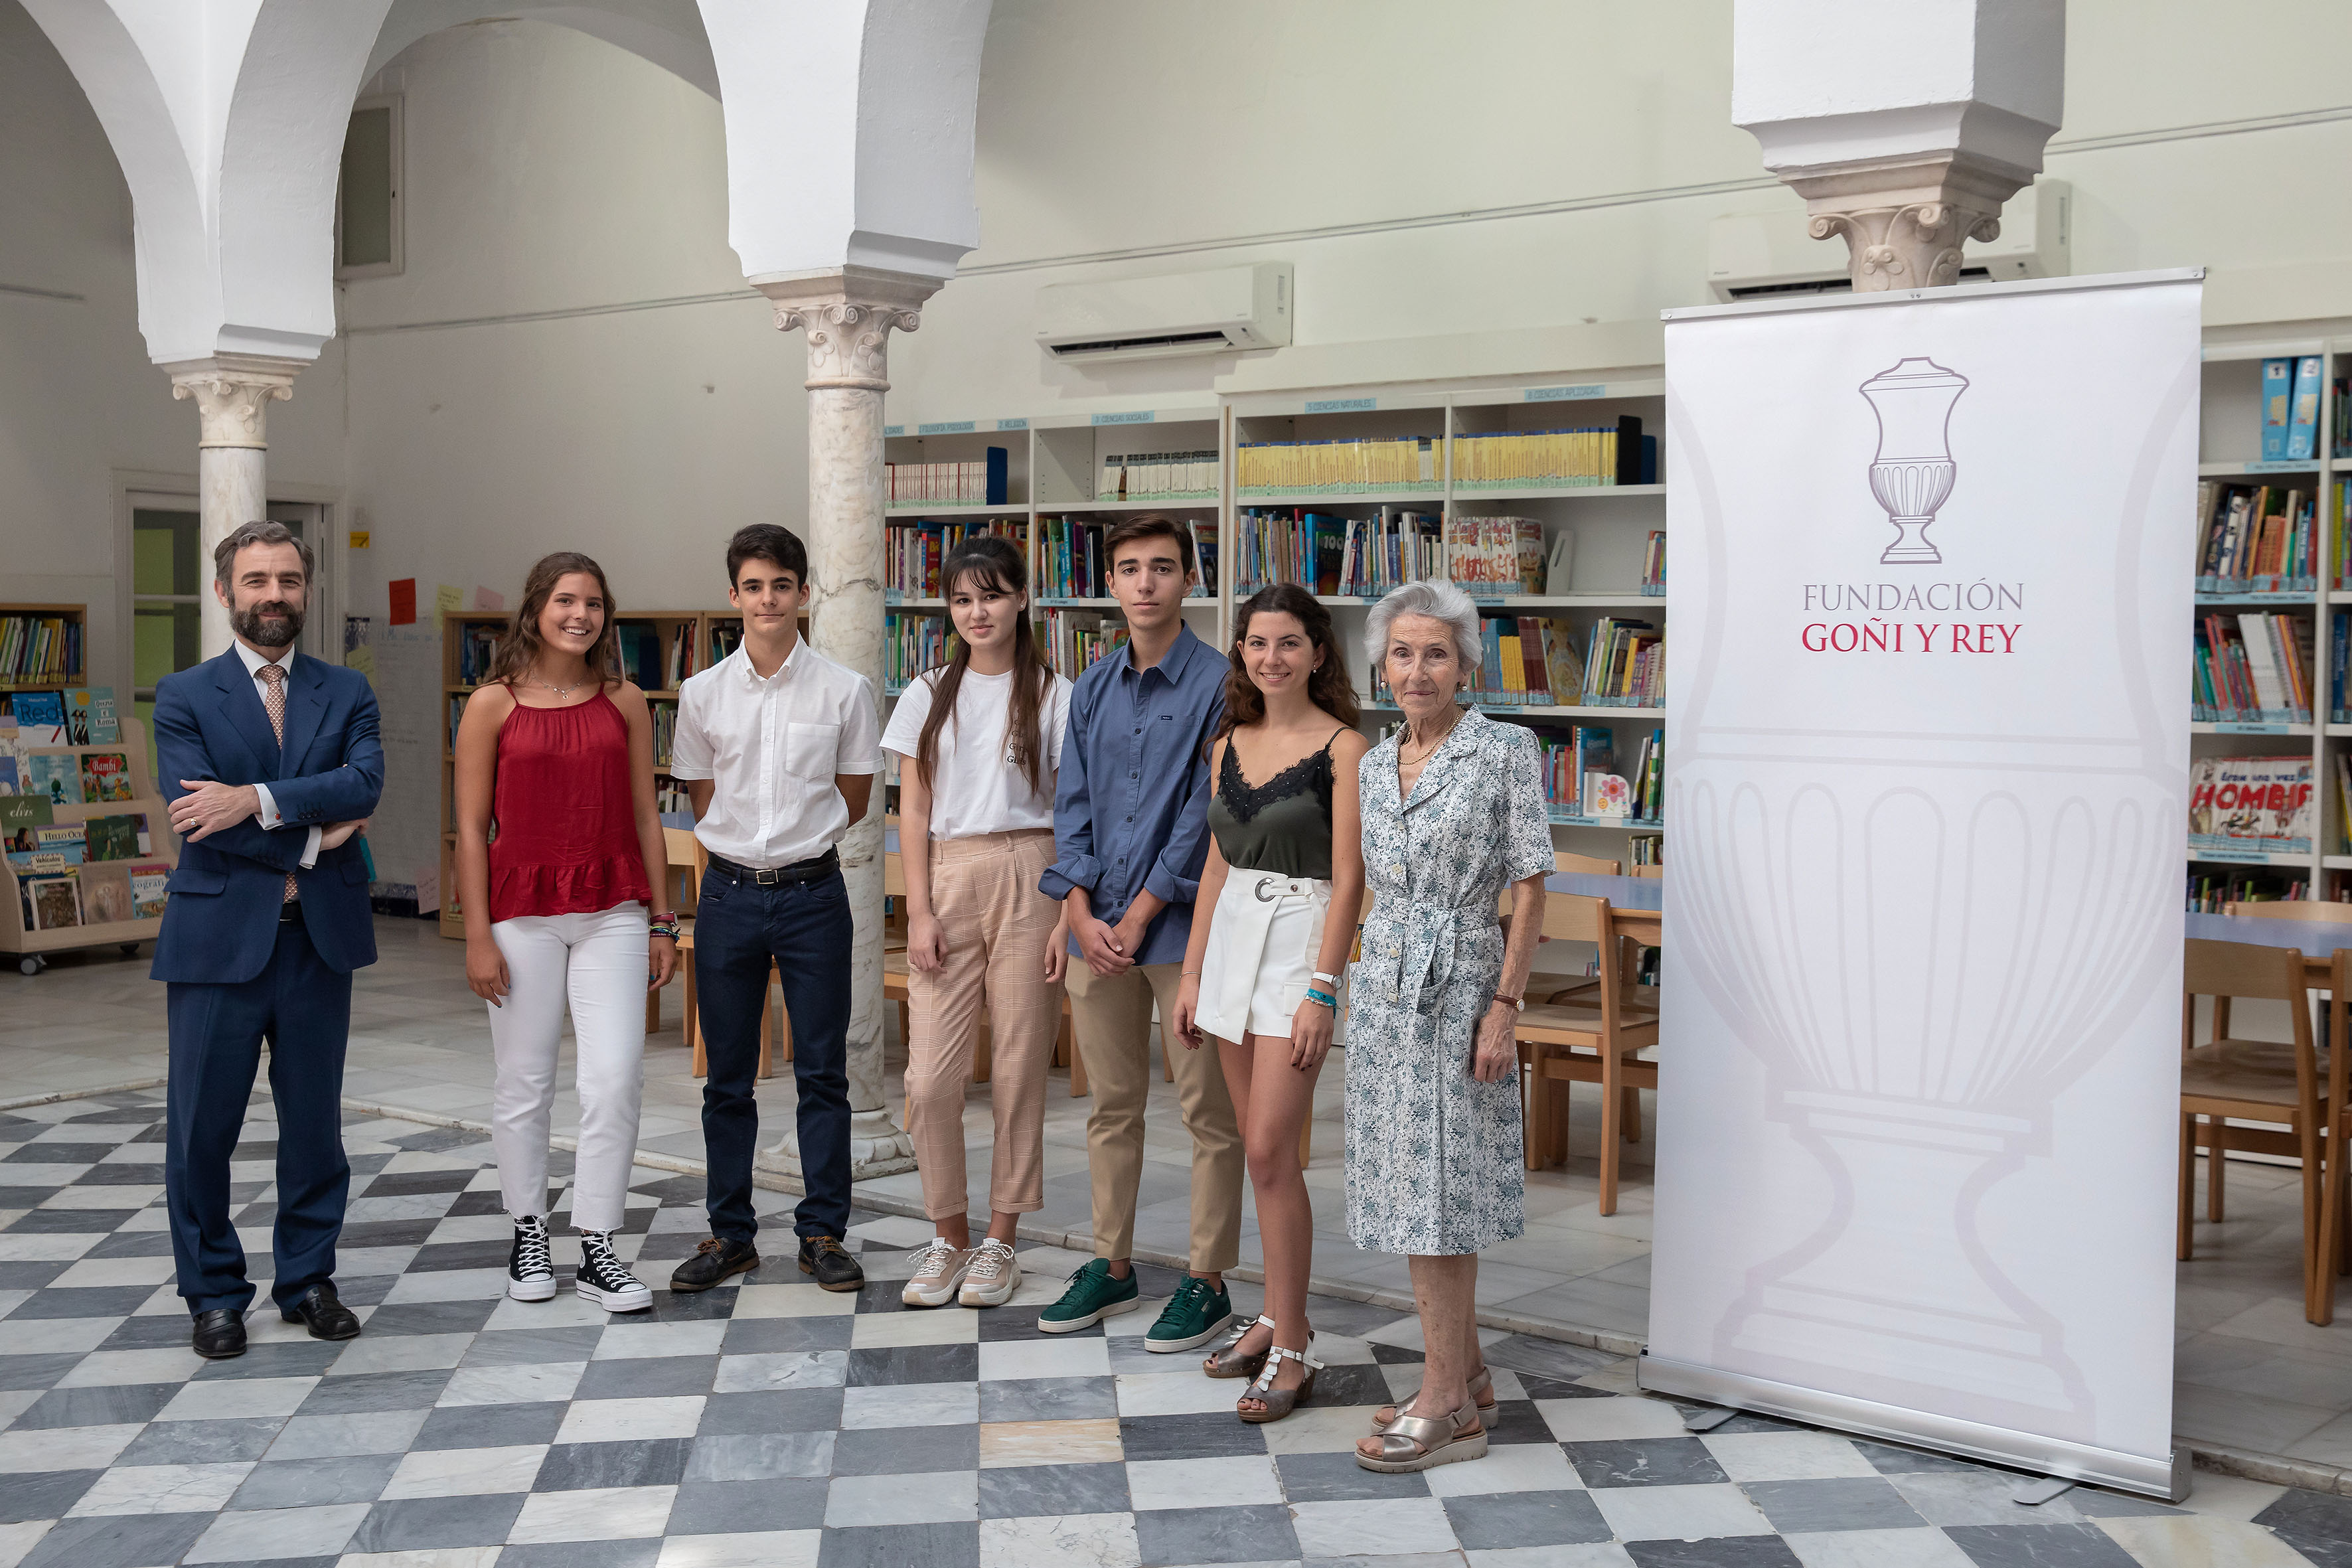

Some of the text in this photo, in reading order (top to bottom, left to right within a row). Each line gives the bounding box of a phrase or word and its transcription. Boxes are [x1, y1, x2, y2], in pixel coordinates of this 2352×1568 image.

[1533, 388, 1563, 398] CIENCIAS
[1313, 401, 1339, 410] CIENCIAS
[1340, 399, 1371, 409] NATURALES
[1101, 414, 1125, 423] CIENCIAS
[1125, 412, 1150, 421] SOCIALES
[1803, 578, 2025, 611] FUNDACIÓN
[1802, 617, 2024, 654] GOÑI Y REY
[20, 702, 60, 722] Red
[92, 759, 117, 771] Bambi
[68, 830, 86, 839] OCEA
